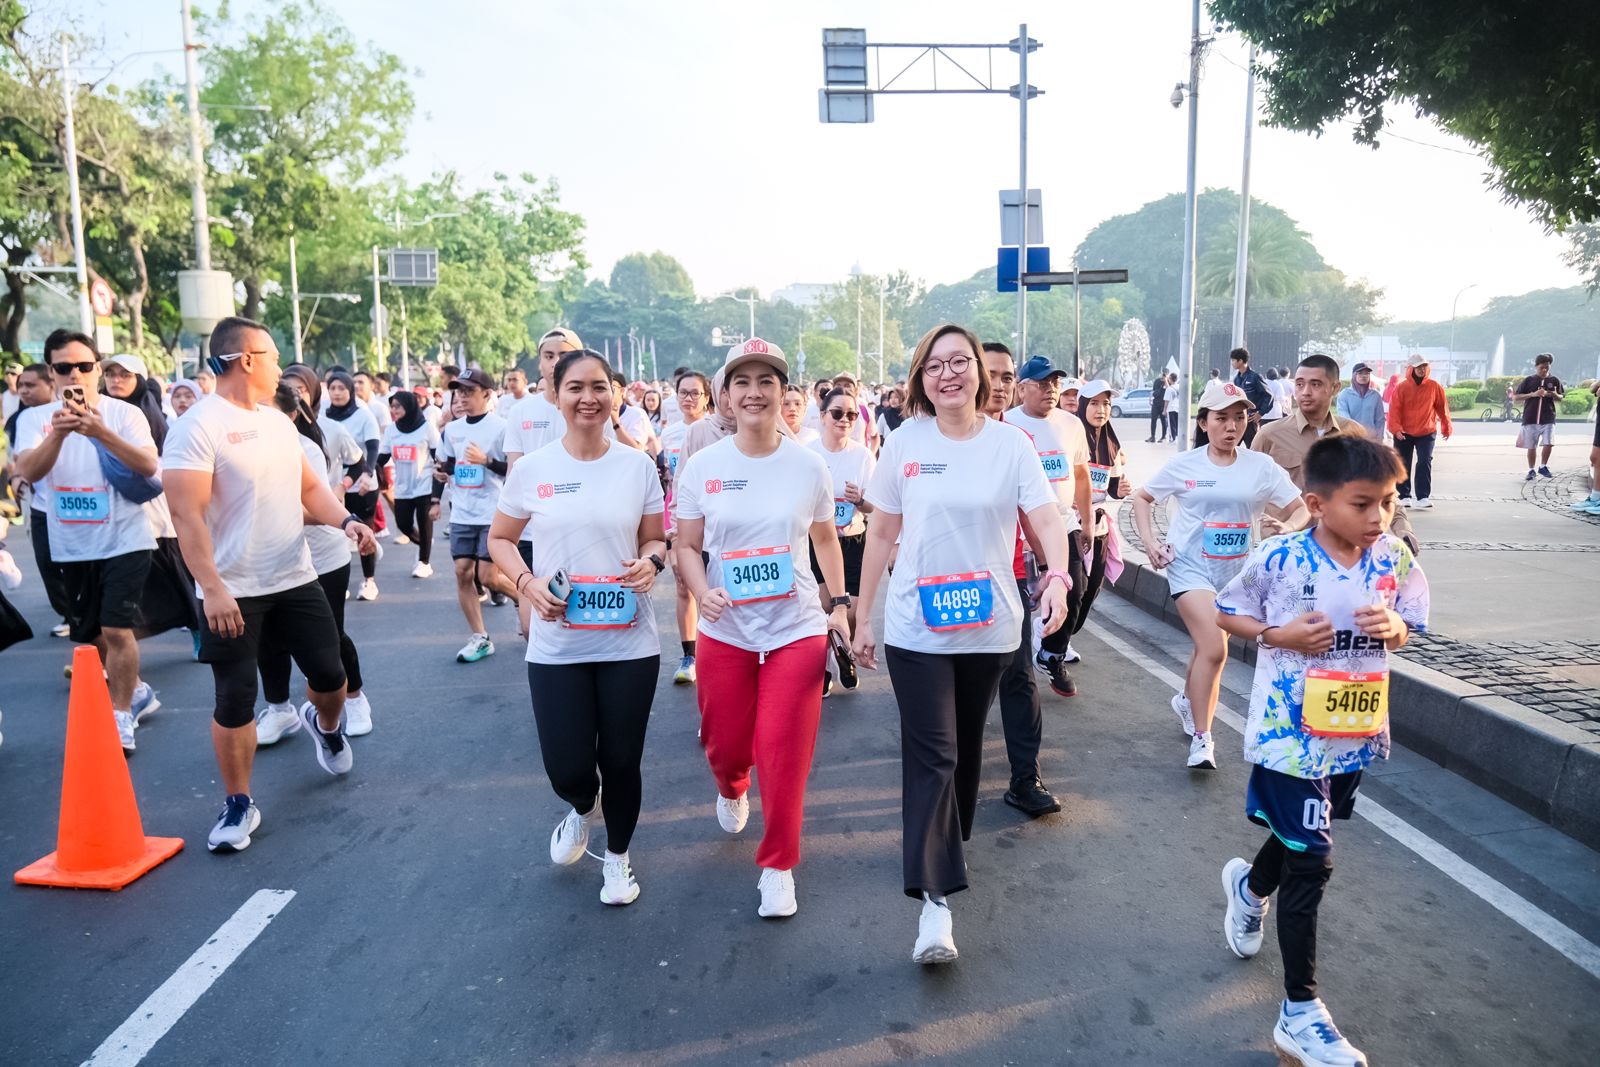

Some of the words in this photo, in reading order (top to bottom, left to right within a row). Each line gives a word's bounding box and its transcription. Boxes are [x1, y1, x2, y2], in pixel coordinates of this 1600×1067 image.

[60, 496, 97, 510] 35055
[1213, 533, 1247, 546] 35578
[733, 562, 780, 585] 34038
[577, 590, 625, 609] 34026
[932, 587, 981, 611] 44899
[1325, 690, 1381, 713] 54166
[1303, 798, 1333, 830] 09
